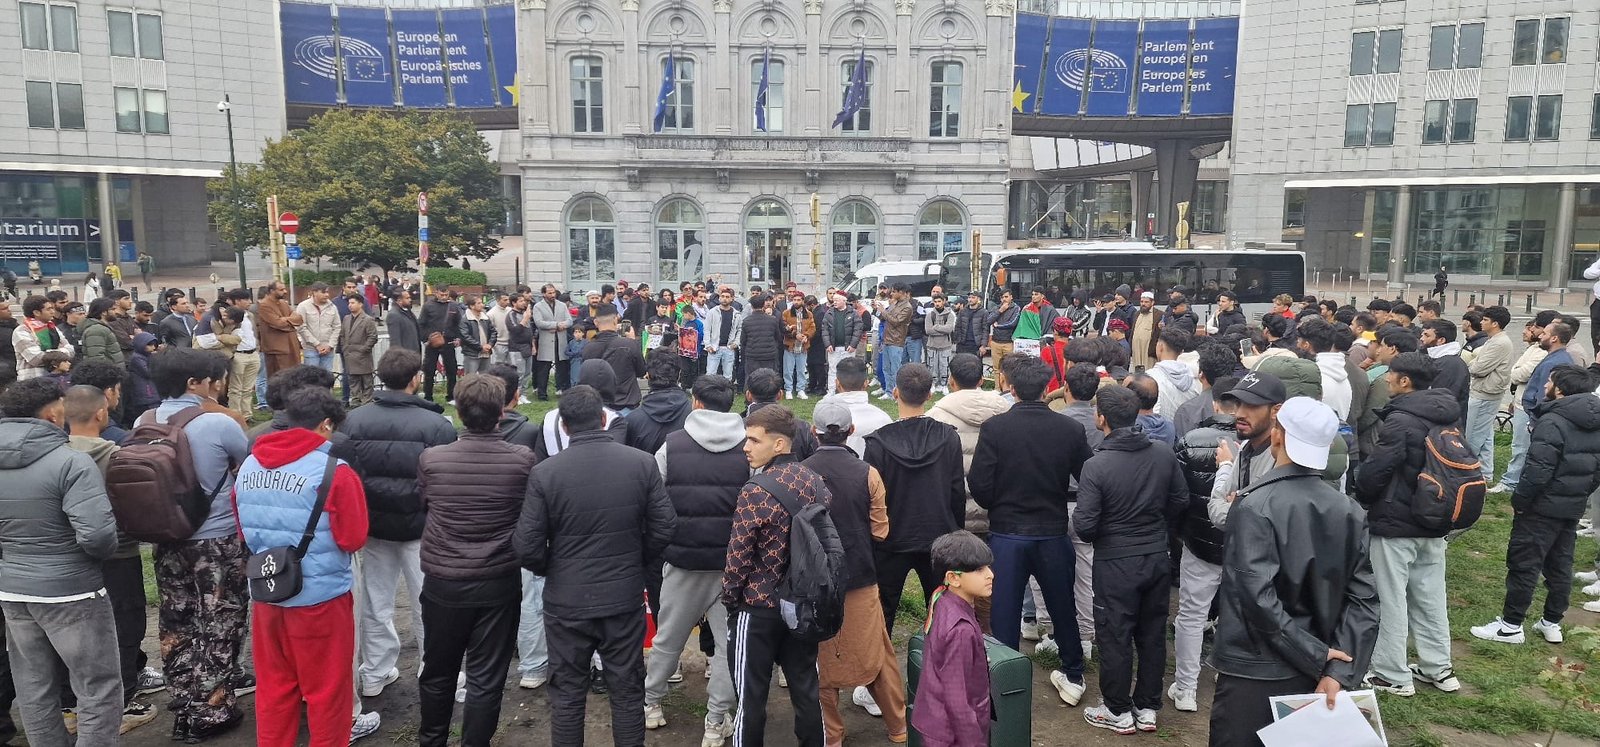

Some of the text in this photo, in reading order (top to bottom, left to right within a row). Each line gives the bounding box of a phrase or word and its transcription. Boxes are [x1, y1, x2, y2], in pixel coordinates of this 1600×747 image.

[397, 31, 457, 44] European
[399, 45, 468, 56] Parliament
[1144, 40, 1214, 52] Parlement
[1143, 53, 1208, 66] européen
[400, 60, 482, 72] Europäisches
[402, 73, 469, 84] Parlament
[1142, 70, 1206, 81] Europees
[1141, 82, 1212, 93] Parlement
[0, 220, 79, 236] tarium
[242, 470, 307, 495] HOODRICH
